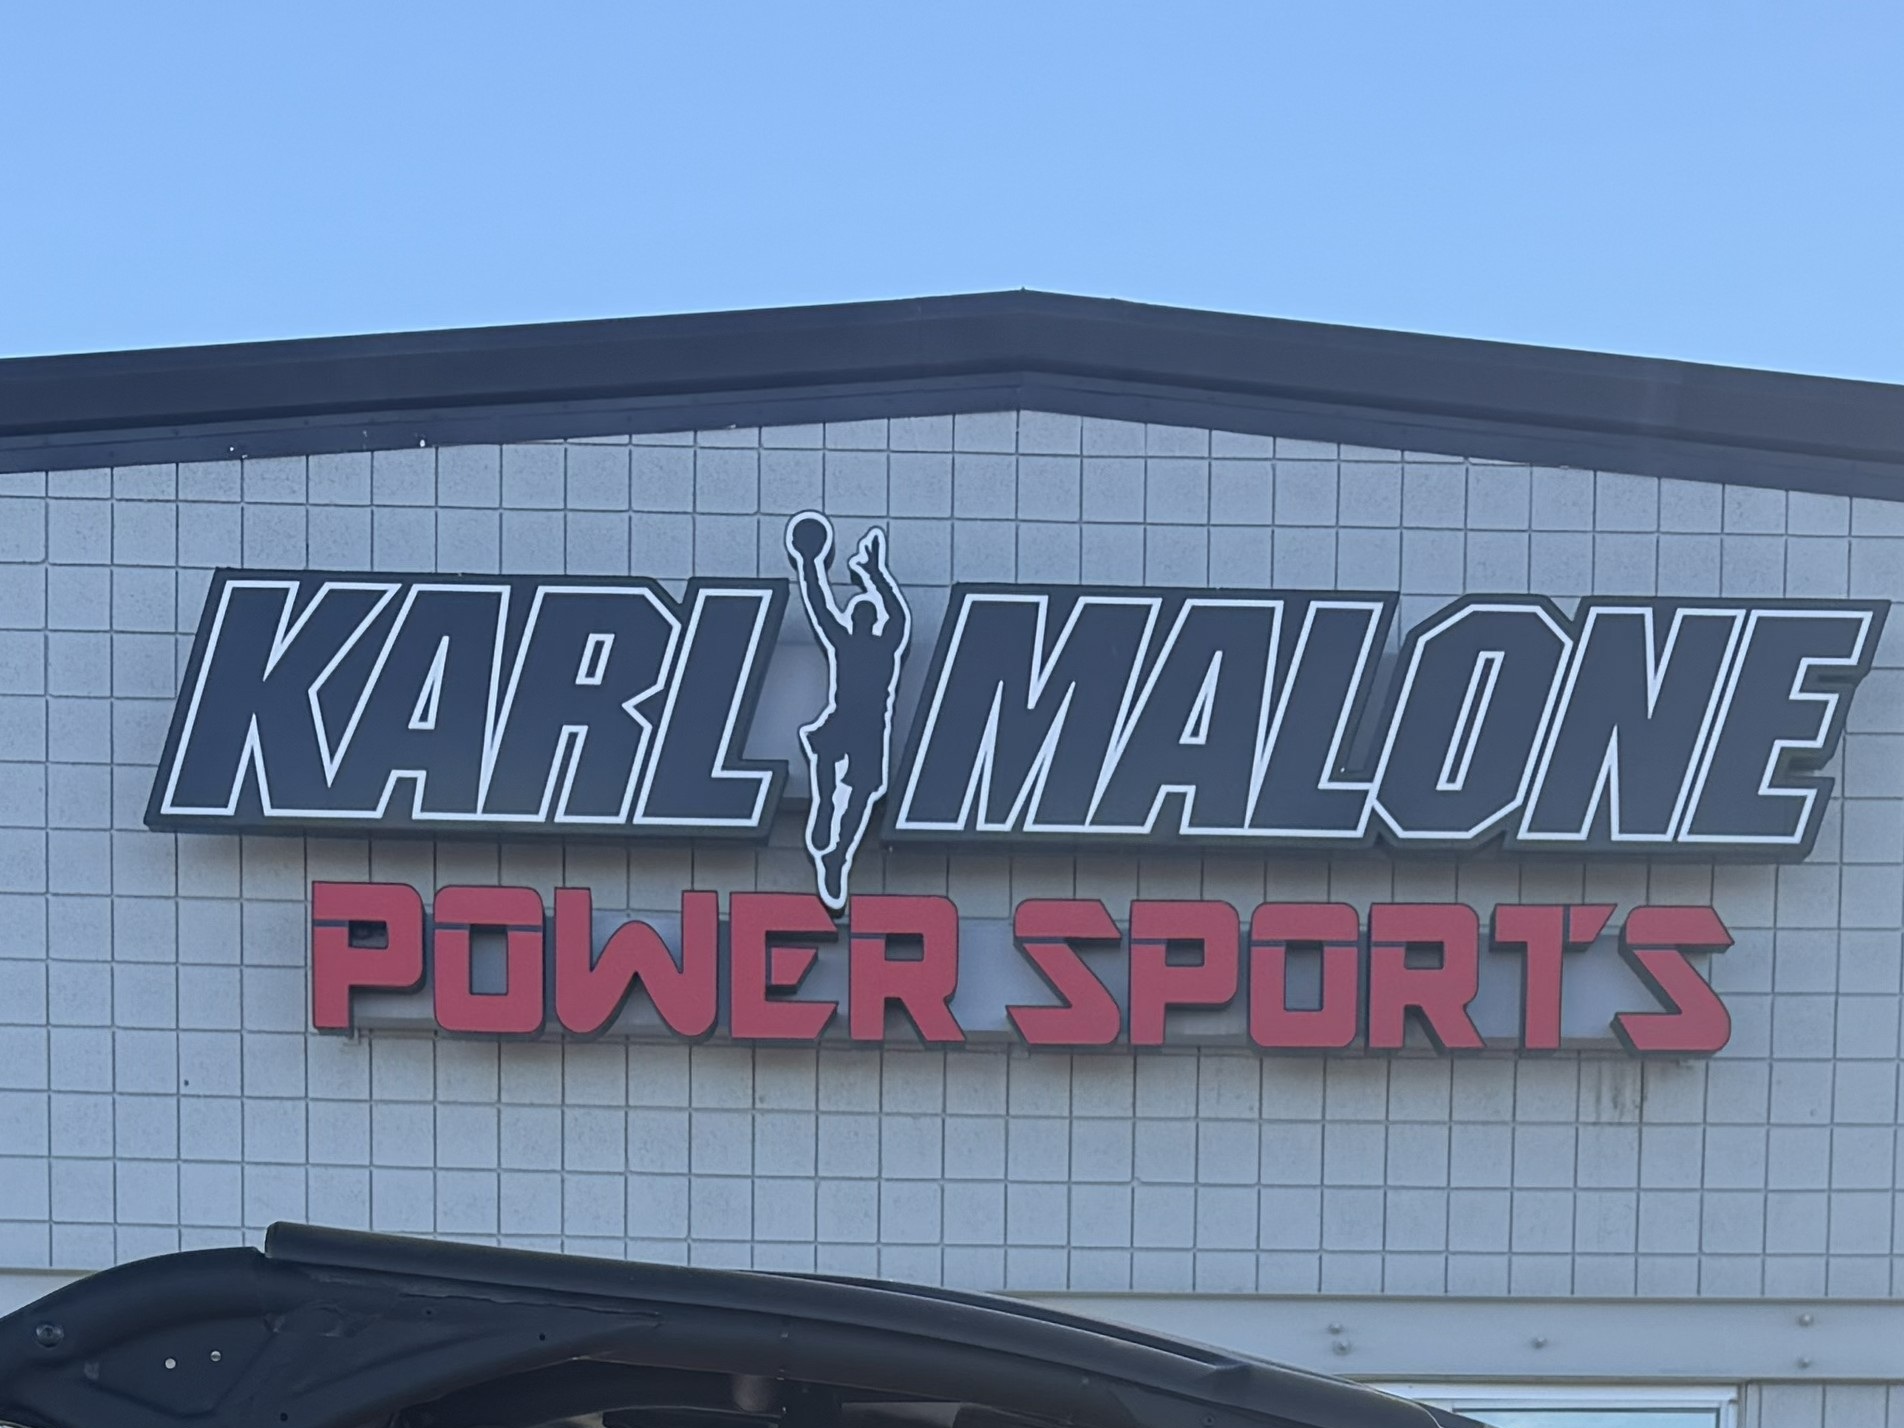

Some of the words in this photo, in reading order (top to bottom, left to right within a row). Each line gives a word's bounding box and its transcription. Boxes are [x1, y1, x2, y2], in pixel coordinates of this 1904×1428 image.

[145, 569, 789, 840] KARL
[884, 583, 1889, 861] MALONE
[310, 880, 966, 1044] POWER
[1009, 896, 1738, 1055] SPORTS
